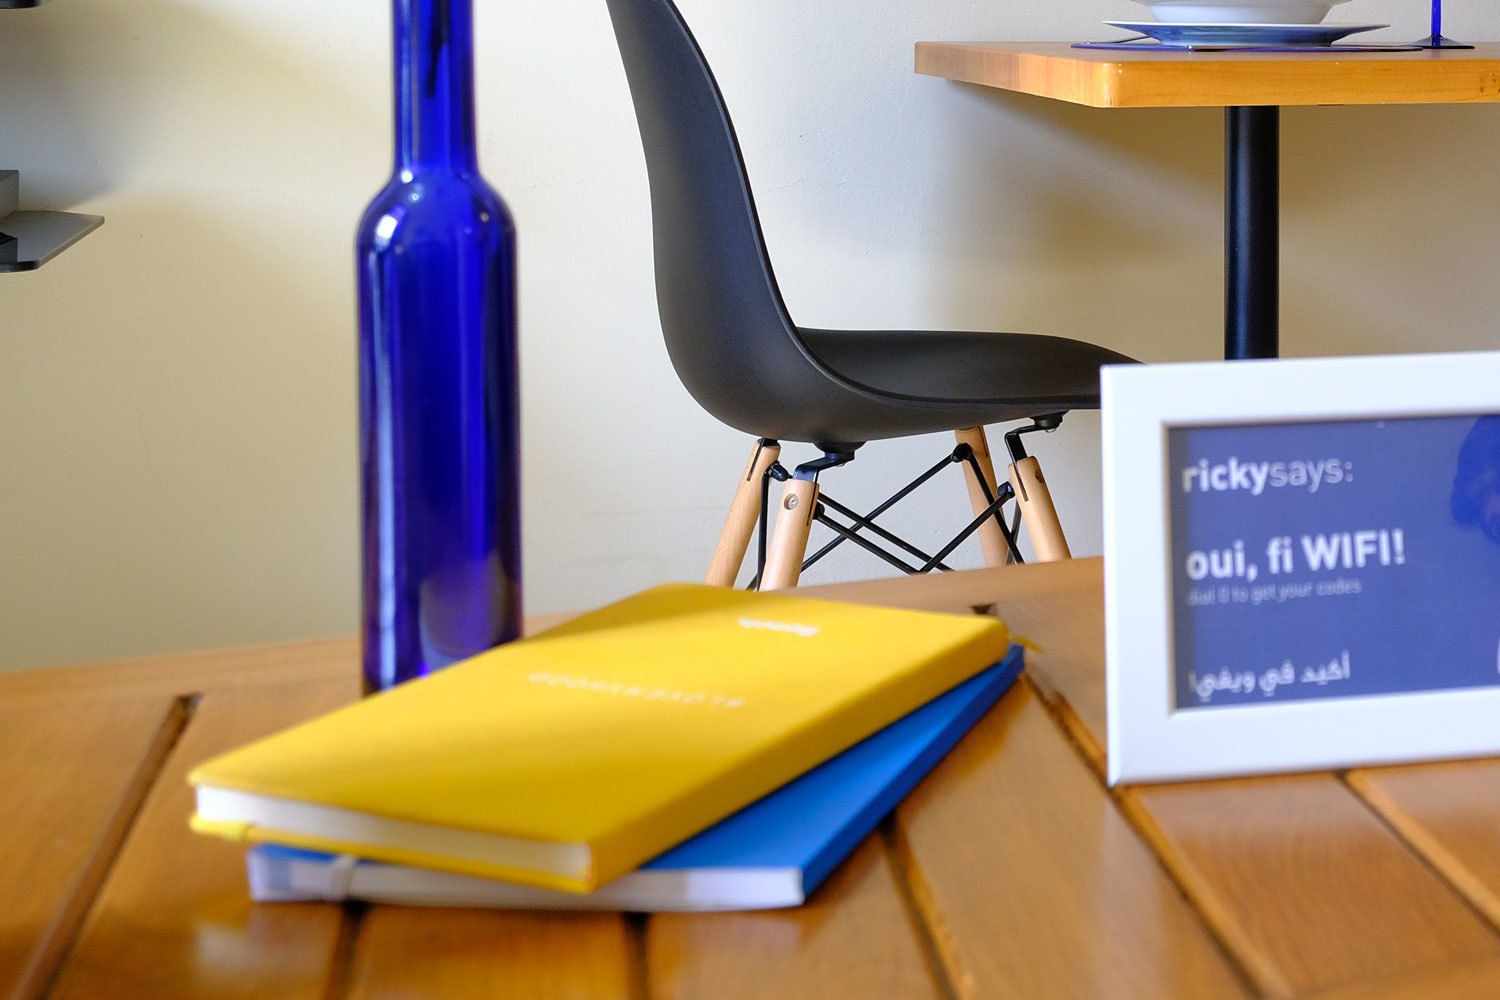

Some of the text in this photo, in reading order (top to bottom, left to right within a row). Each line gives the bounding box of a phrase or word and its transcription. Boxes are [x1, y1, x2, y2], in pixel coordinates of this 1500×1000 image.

[1182, 456, 1354, 496] rickysays:
[1186, 528, 1405, 582] oui, fi WIFI!
[1251, 583, 1276, 605] get
[1278, 581, 1314, 603] your
[1315, 577, 1363, 596] codes
